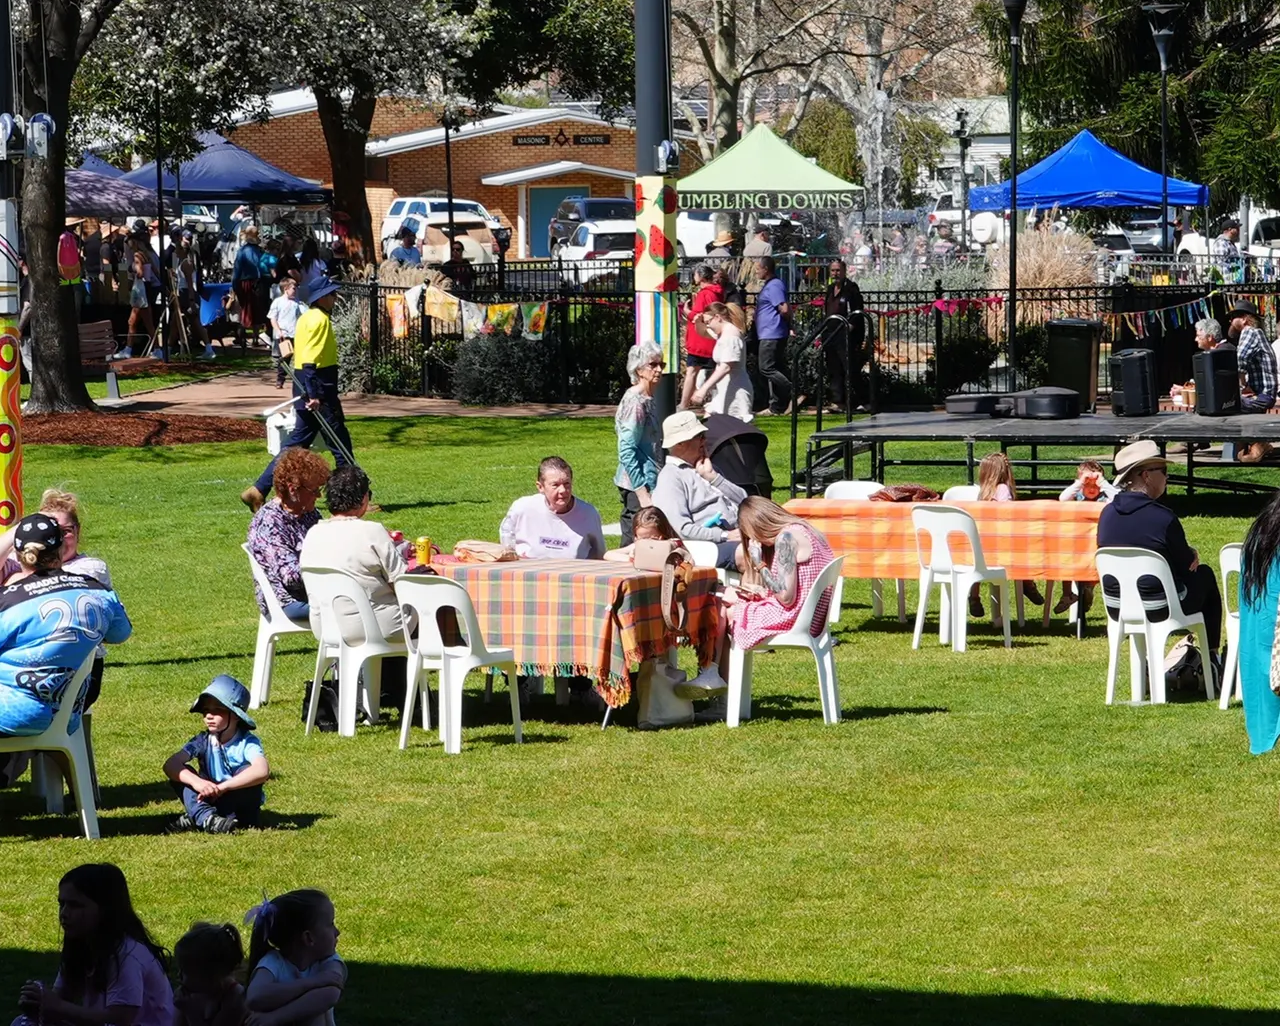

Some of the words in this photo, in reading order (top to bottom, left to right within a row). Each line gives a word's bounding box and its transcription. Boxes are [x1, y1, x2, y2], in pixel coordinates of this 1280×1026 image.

[677, 193, 770, 210] UMBLING
[777, 193, 854, 209] DOWNS
[23, 576, 59, 593] DEADLY
[38, 593, 104, 643] 20
